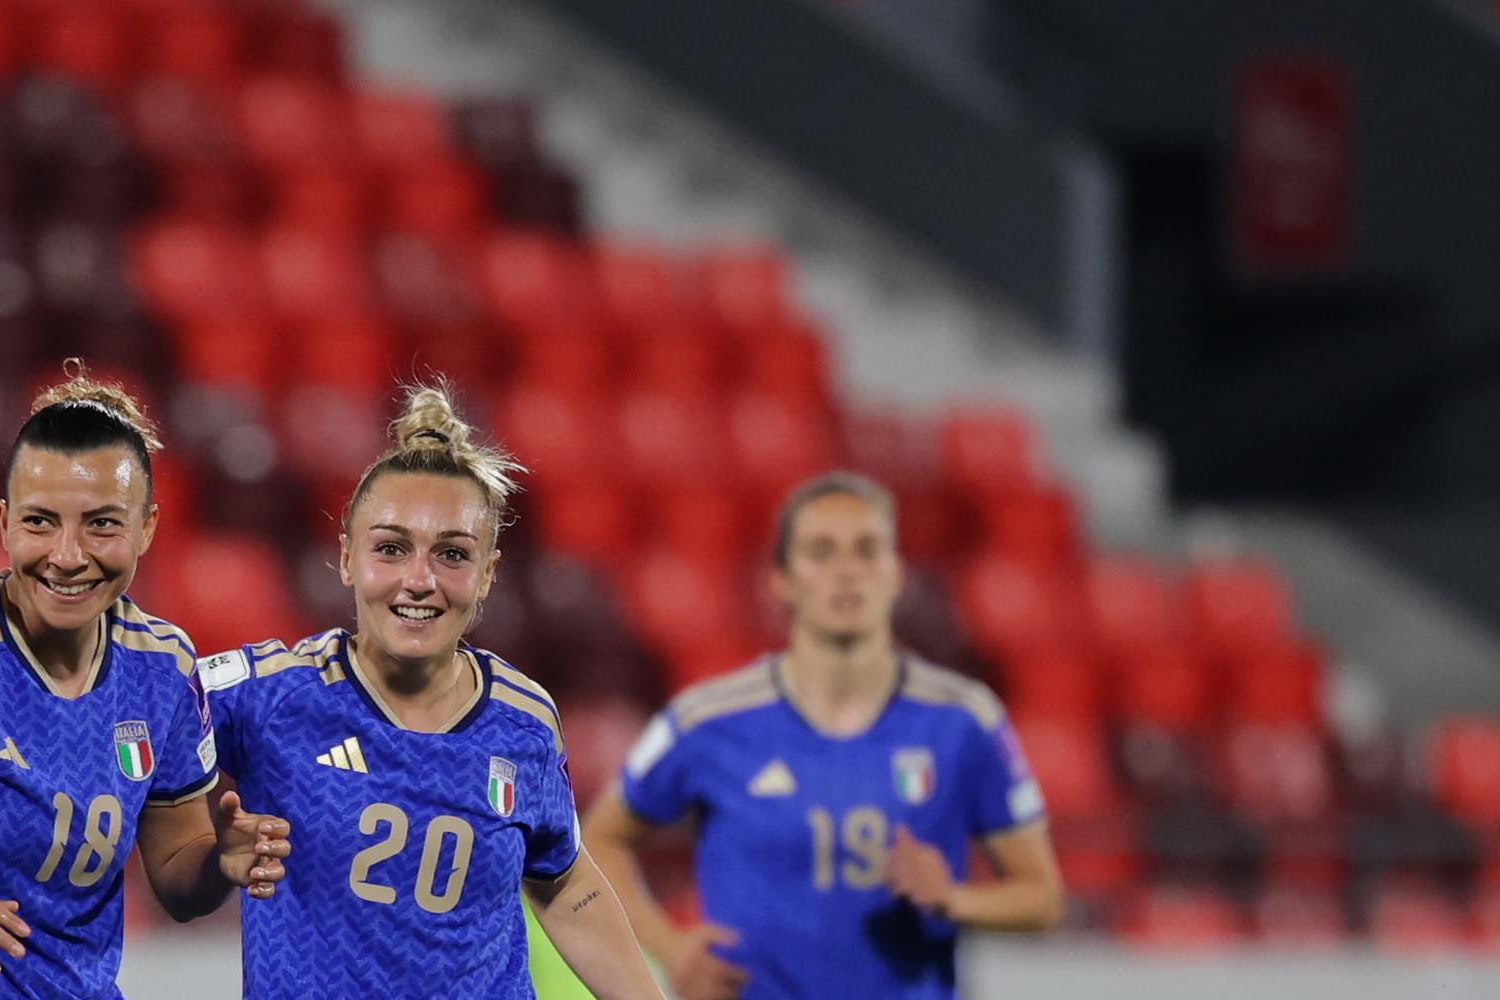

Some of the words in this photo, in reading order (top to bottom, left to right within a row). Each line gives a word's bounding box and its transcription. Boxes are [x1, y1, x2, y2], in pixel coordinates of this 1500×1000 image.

[36, 792, 122, 887] 18
[350, 803, 474, 914] 20
[808, 807, 888, 891] 19
